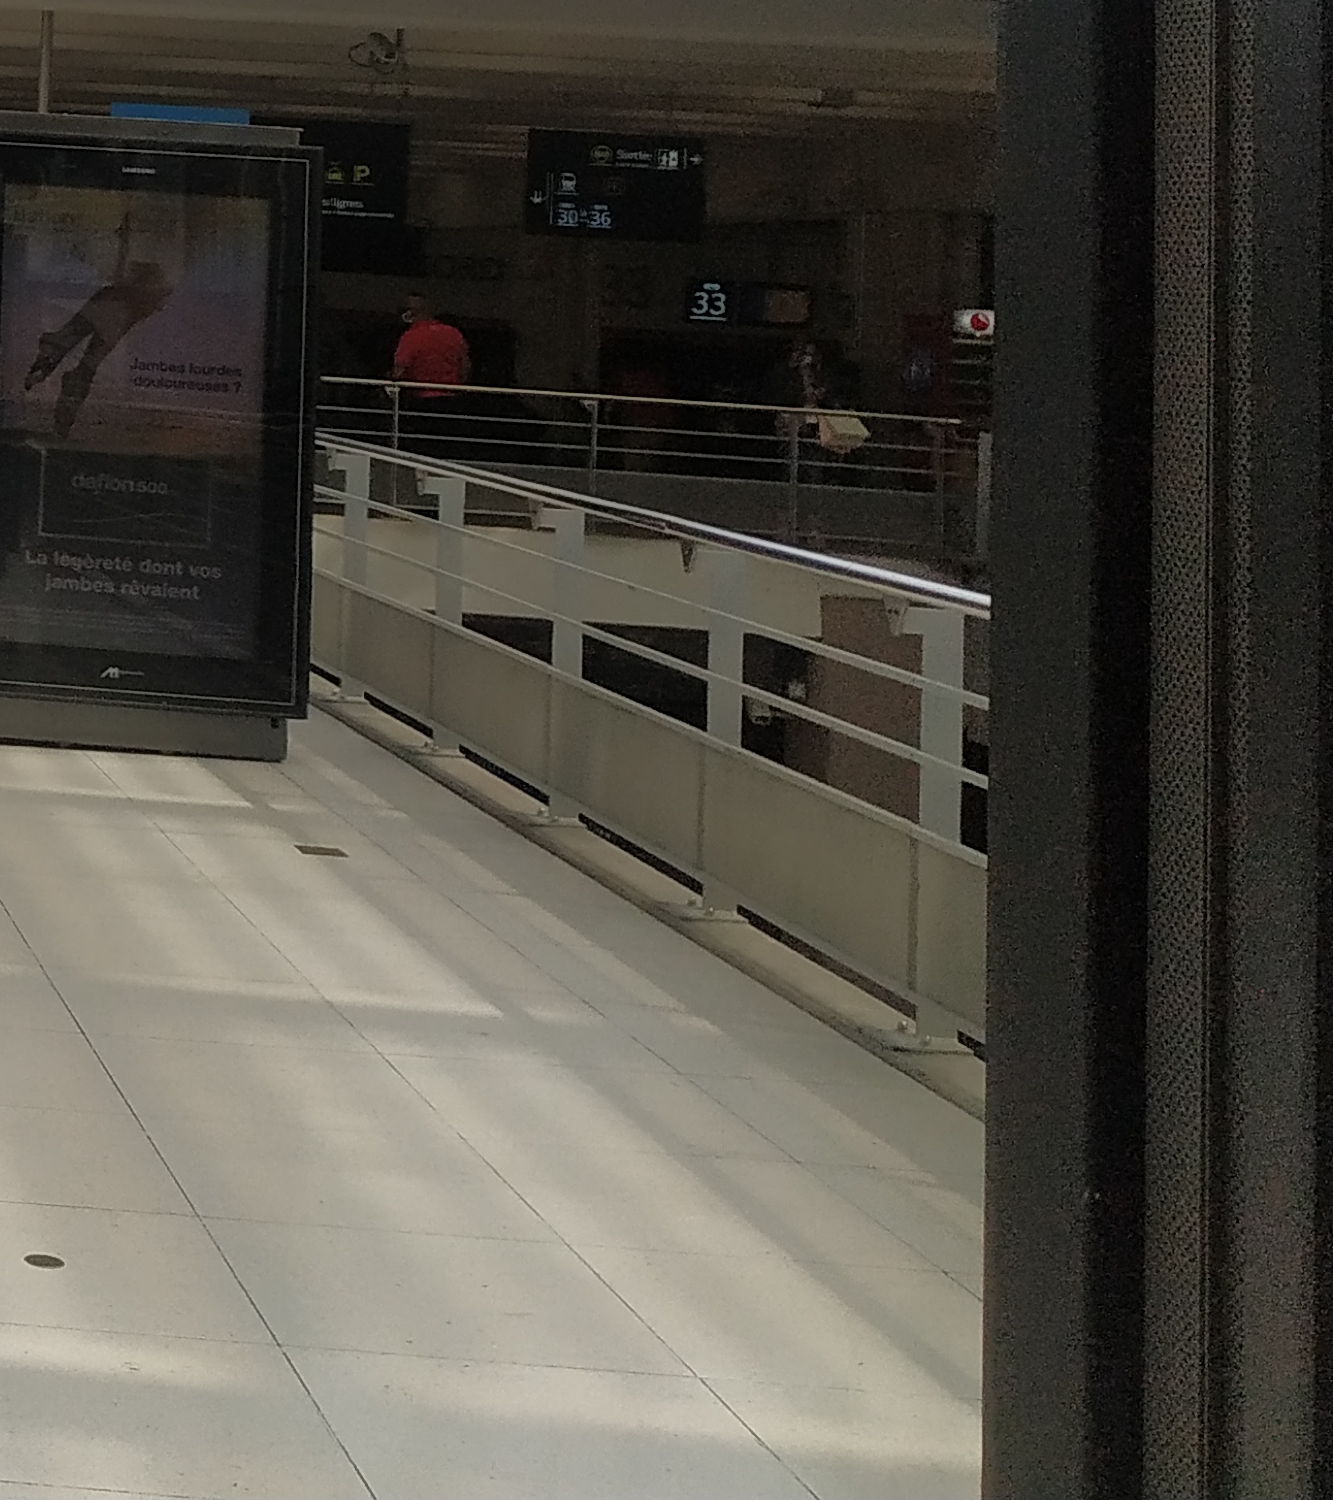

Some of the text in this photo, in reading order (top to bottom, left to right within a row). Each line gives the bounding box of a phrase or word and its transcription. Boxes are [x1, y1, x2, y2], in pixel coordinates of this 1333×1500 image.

[557, 208, 579, 224] 30
[589, 211, 612, 226] 36
[690, 291, 727, 316] 33
[25, 548, 223, 580] La légèreté dont vos
[45, 573, 202, 600] jambes rêvaient
